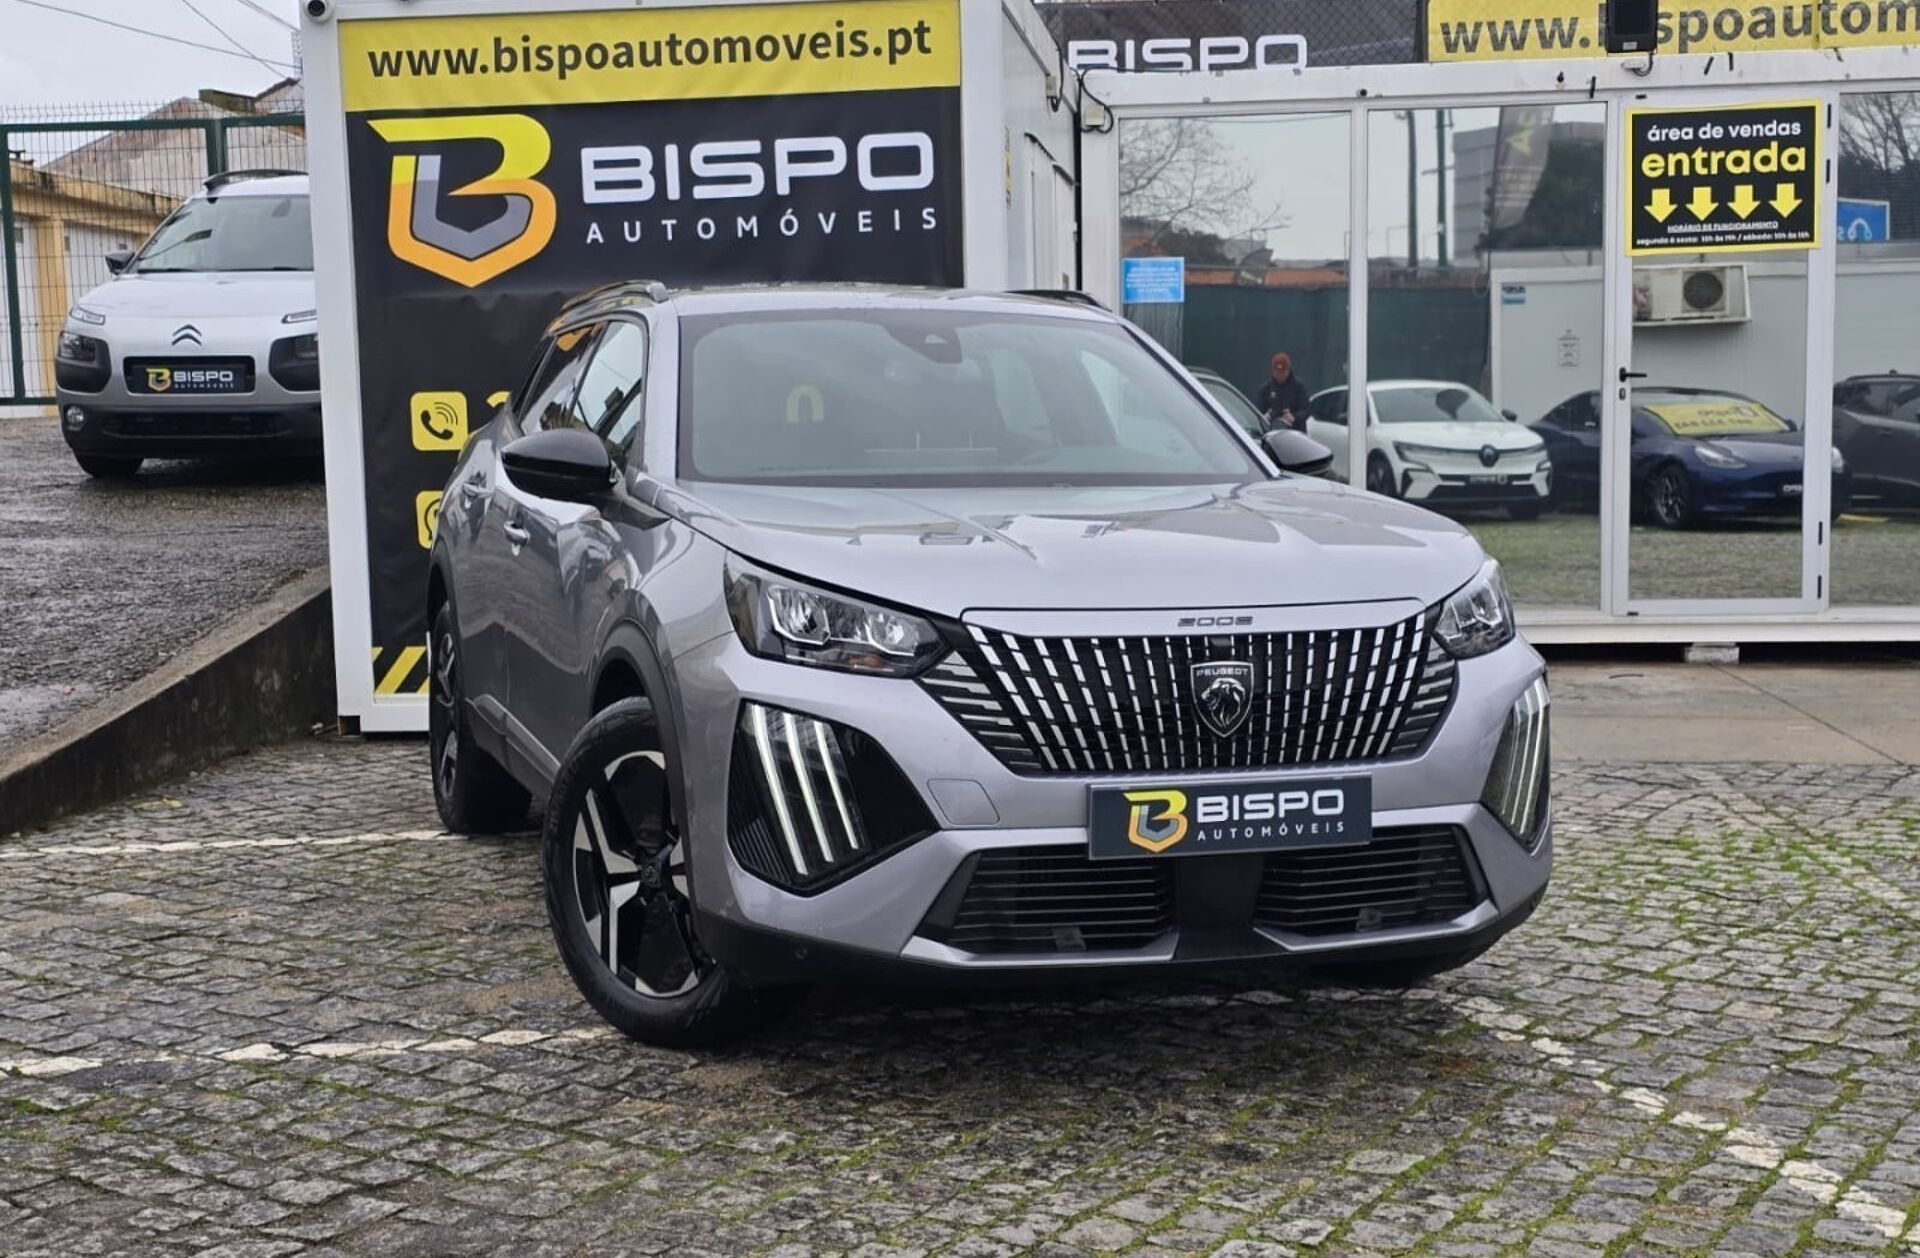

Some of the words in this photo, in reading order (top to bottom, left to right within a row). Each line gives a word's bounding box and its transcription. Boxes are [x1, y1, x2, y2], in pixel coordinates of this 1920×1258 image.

[1440, 0, 1920, 54] www.spoautom
[368, 20, 932, 80] www.bispoautomoveis.pt
[1068, 34, 1308, 73] BISPO
[1647, 124, 1694, 142] área
[1698, 122, 1724, 140] de
[1728, 119, 1802, 138] vendas
[580, 131, 935, 205] BISPO
[1641, 140, 1806, 179] entrada
[586, 207, 937, 245] AUTOMÓVEIS
[173, 371, 234, 383] BISPO
[1196, 667, 1249, 676] PEUGEOT
[1196, 789, 1345, 823] BISPO
[1197, 821, 1345, 841] AUTOMÓVEIS
